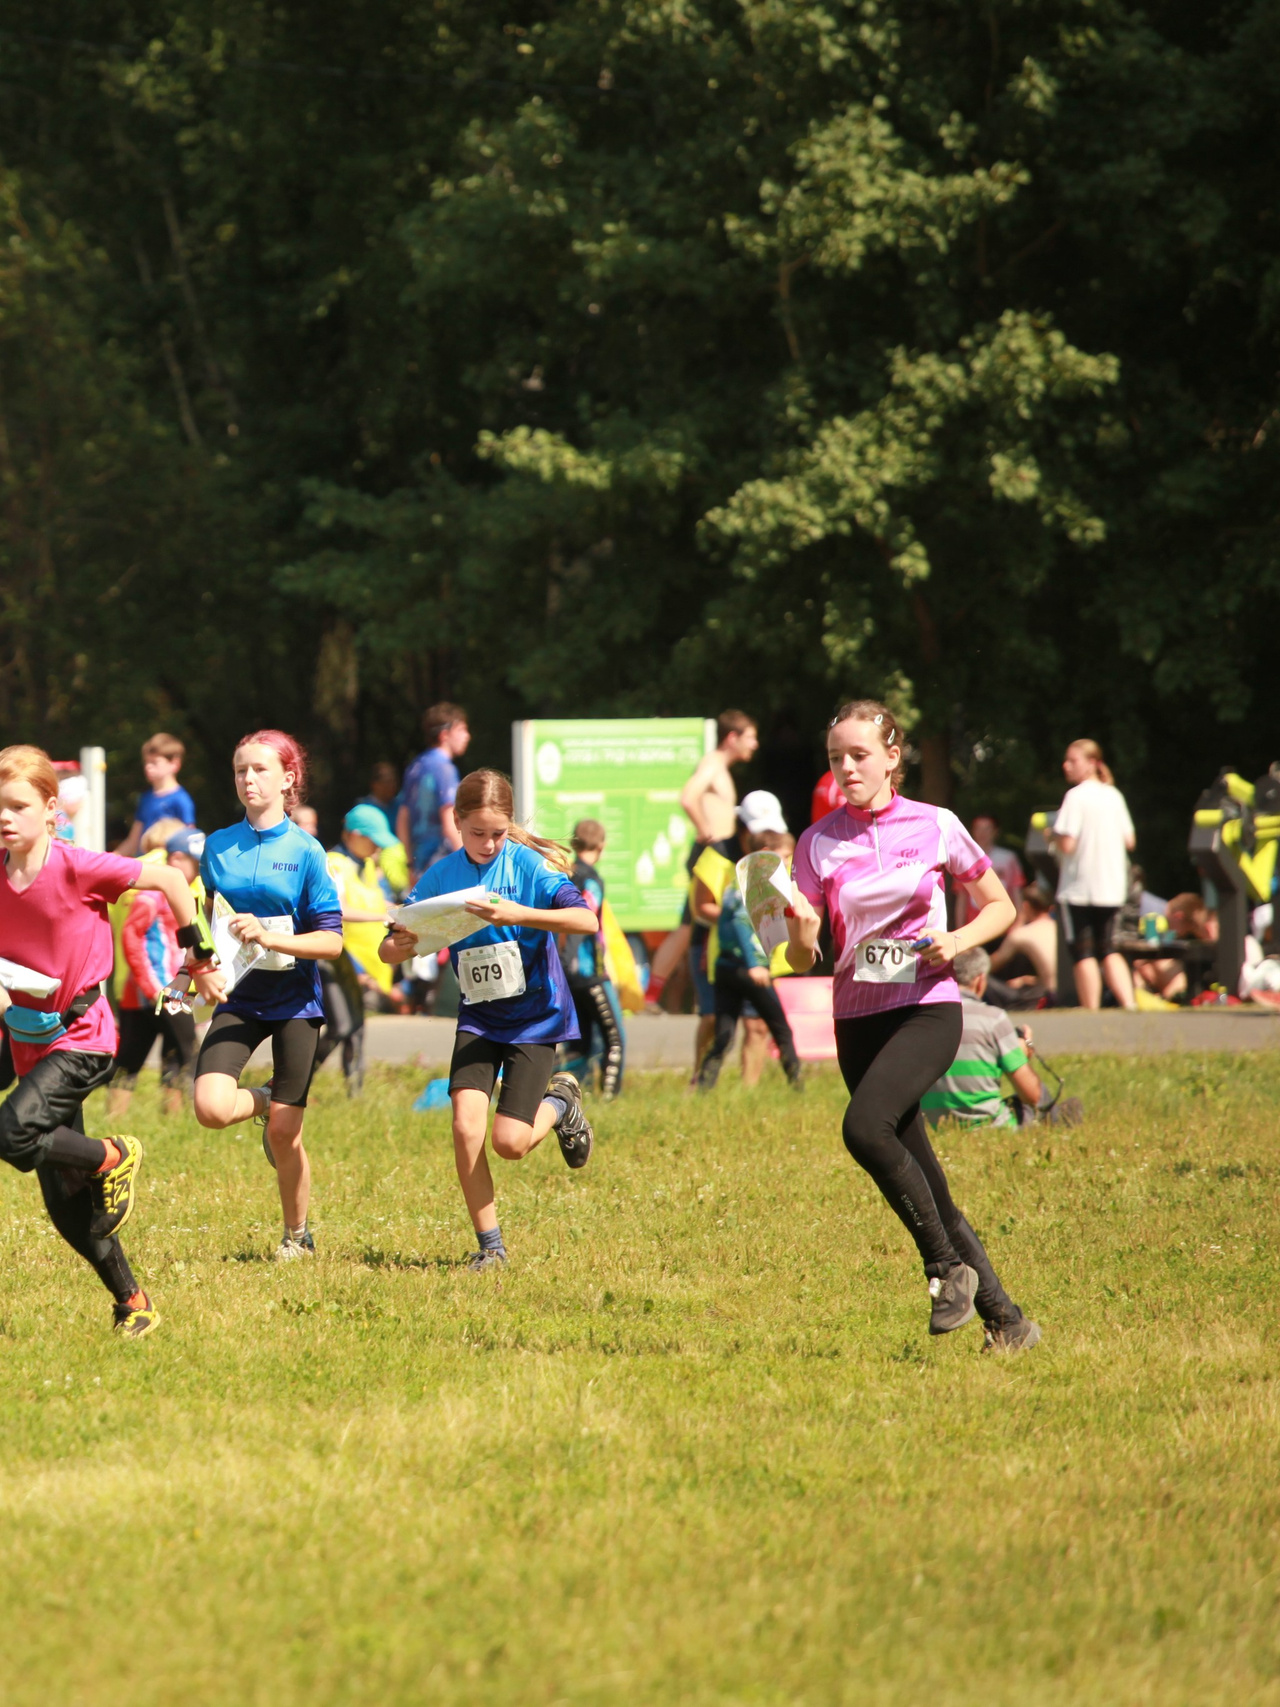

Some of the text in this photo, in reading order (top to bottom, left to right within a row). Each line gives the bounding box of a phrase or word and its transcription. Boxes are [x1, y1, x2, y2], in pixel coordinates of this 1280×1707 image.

[272, 861, 299, 872] ИСТОК
[896, 859, 925, 869] ONYX
[865, 944, 904, 966] 670
[471, 963, 503, 984] 679
